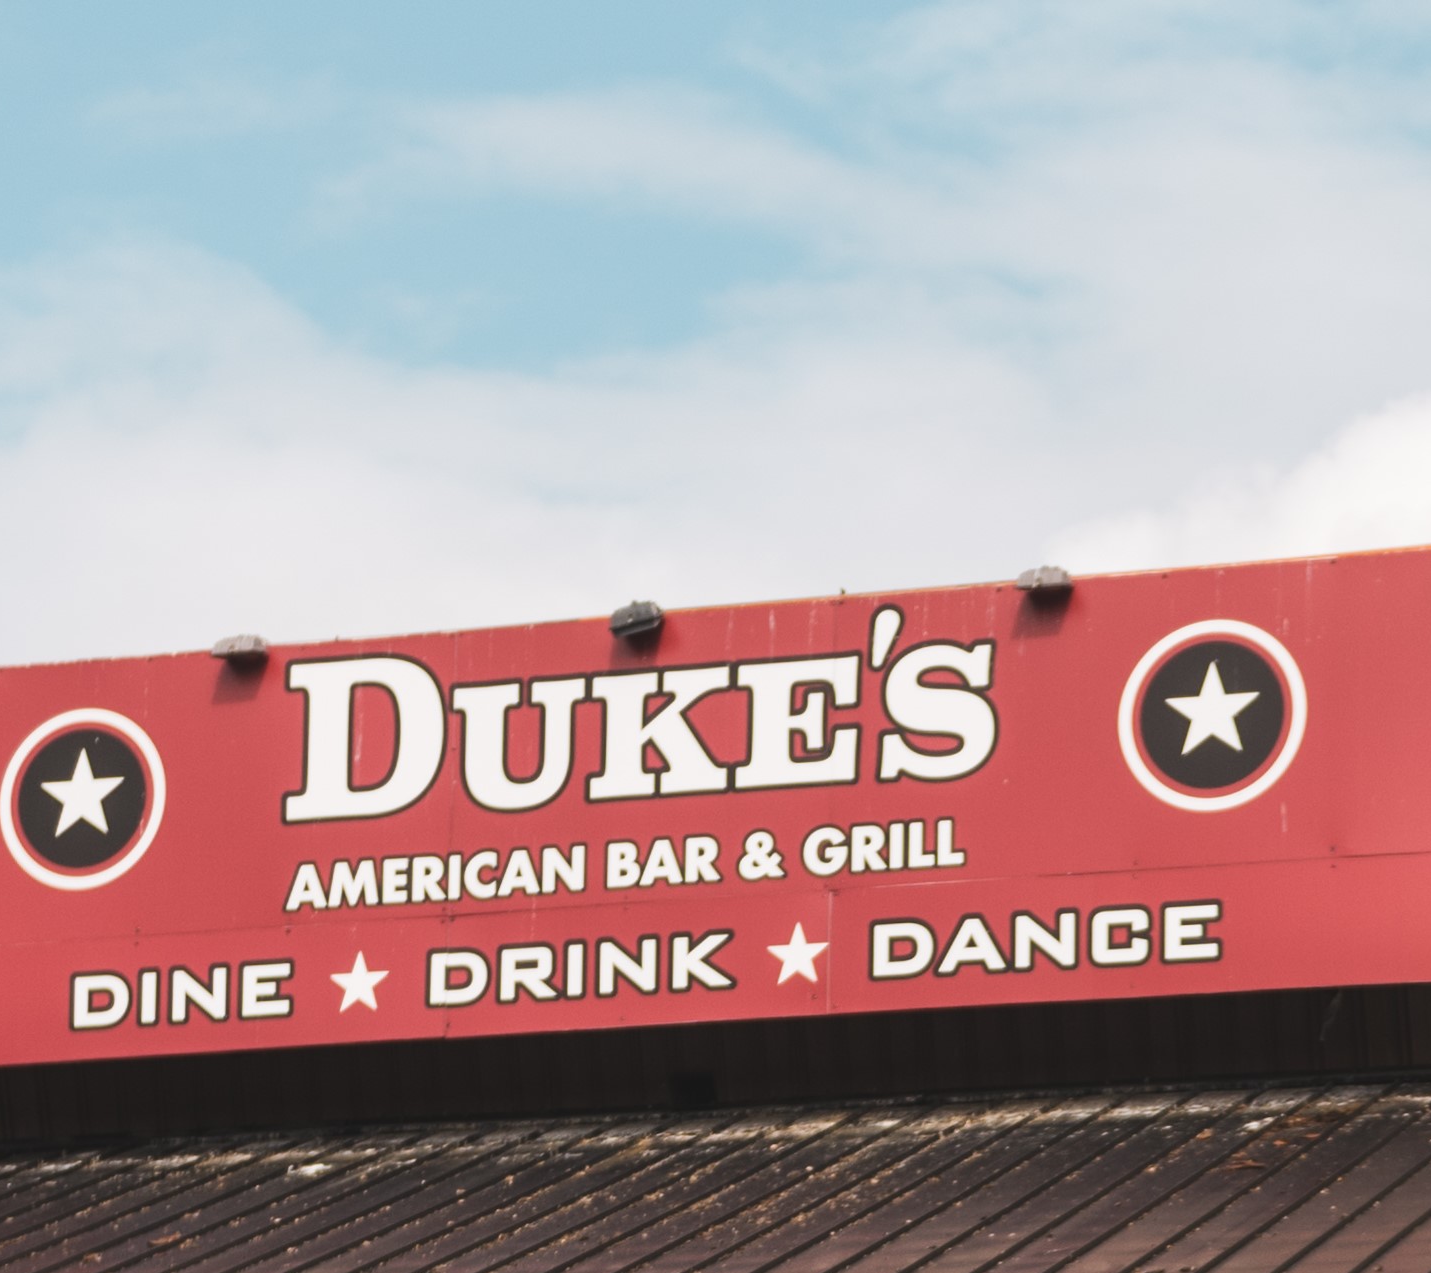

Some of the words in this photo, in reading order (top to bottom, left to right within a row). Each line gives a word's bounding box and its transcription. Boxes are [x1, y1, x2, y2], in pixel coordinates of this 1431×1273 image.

[284, 606, 997, 825] DUKE'S
[286, 841, 588, 915] AMERICAN
[606, 833, 721, 893] BAR
[738, 830, 784, 882] &
[803, 817, 965, 879] GRILL
[70, 958, 293, 1033] DINE
[424, 930, 736, 1008] DRINK
[868, 900, 1224, 981] DANCE
